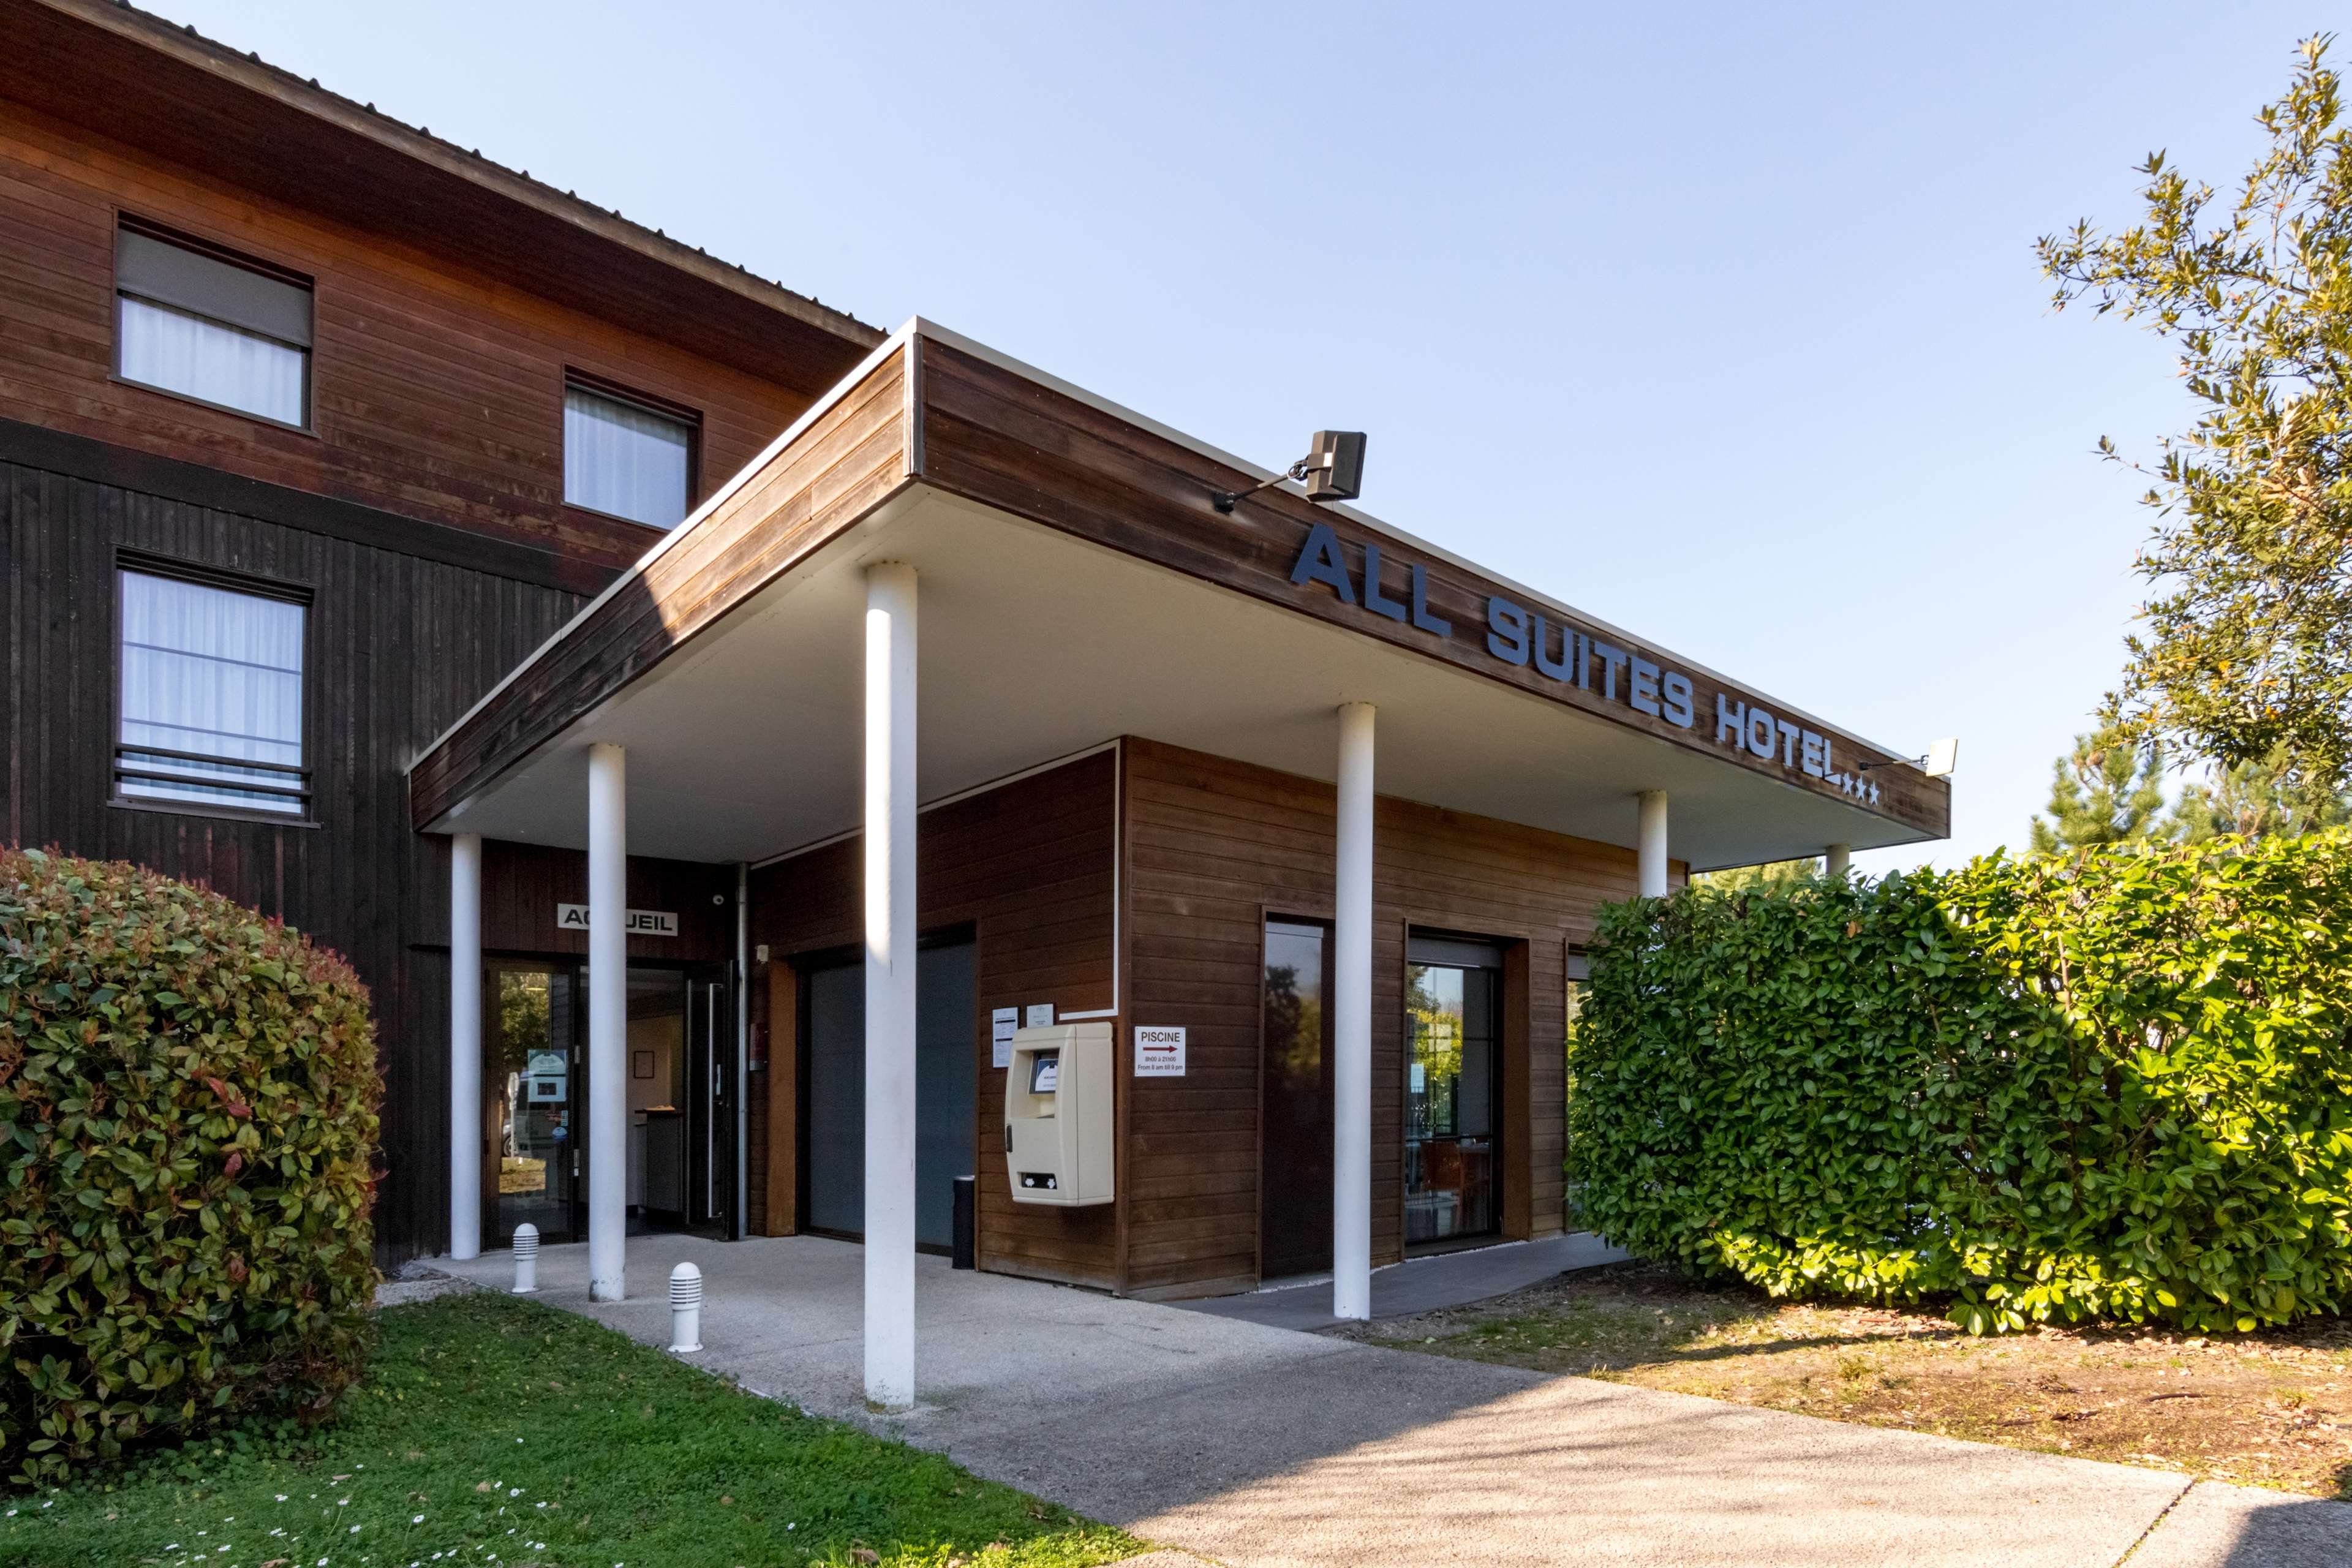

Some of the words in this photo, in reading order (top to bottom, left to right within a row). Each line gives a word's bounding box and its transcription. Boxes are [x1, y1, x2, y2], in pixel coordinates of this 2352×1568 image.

[1291, 522, 1452, 638] ALL
[1487, 596, 1694, 728] SUITES
[1717, 693, 1841, 785] HOTEL
[565, 909, 673, 931] AUEIL
[1141, 1031, 1180, 1042] PISCINE
